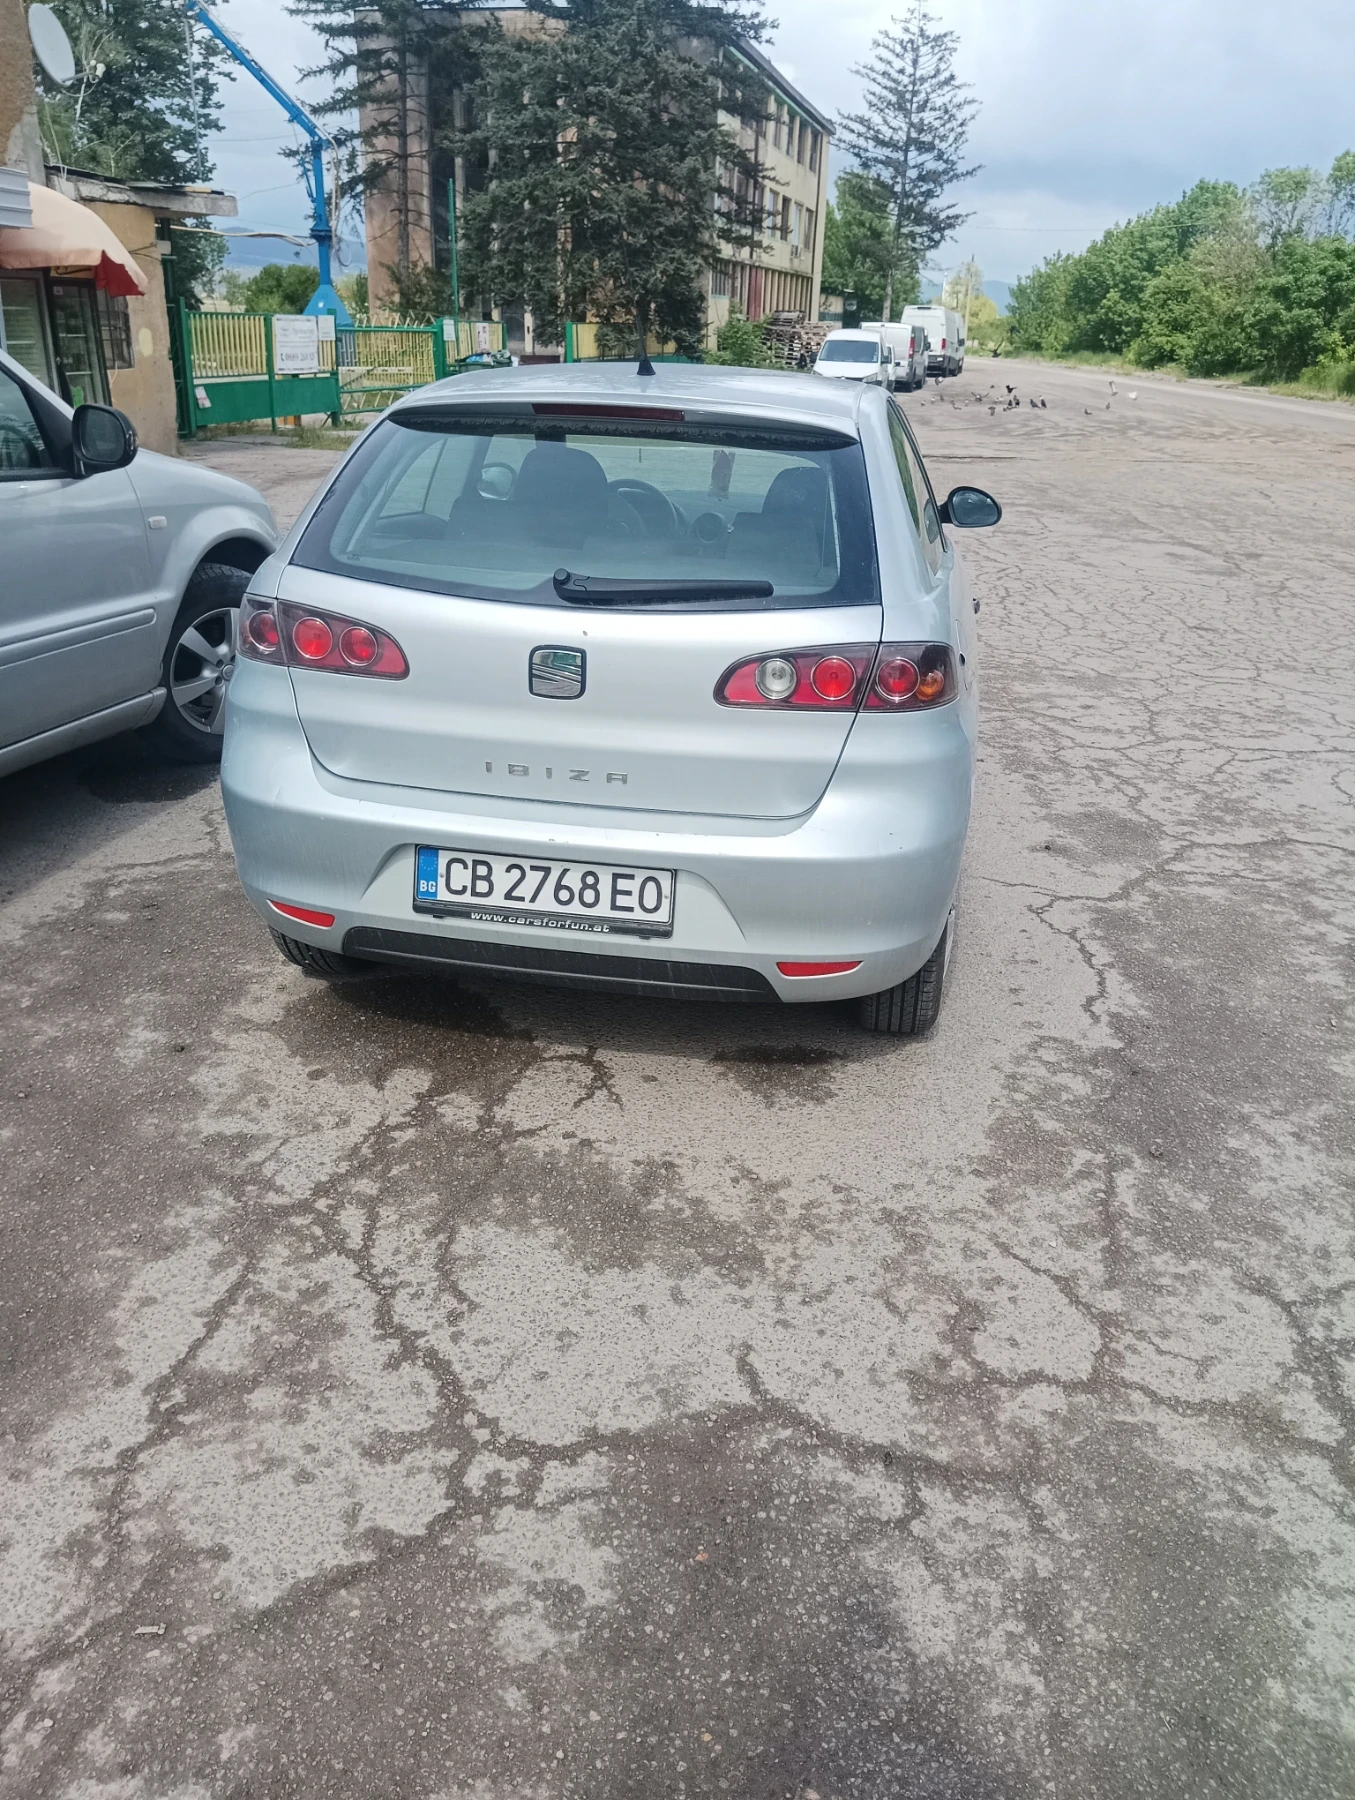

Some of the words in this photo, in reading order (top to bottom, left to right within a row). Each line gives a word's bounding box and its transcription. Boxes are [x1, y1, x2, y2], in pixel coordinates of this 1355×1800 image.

[485, 761, 628, 785] IBIZA
[420, 880, 436, 893] BG
[445, 857, 495, 898] CB
[503, 863, 601, 909] 2768
[470, 911, 610, 932] www.carsforfun.at
